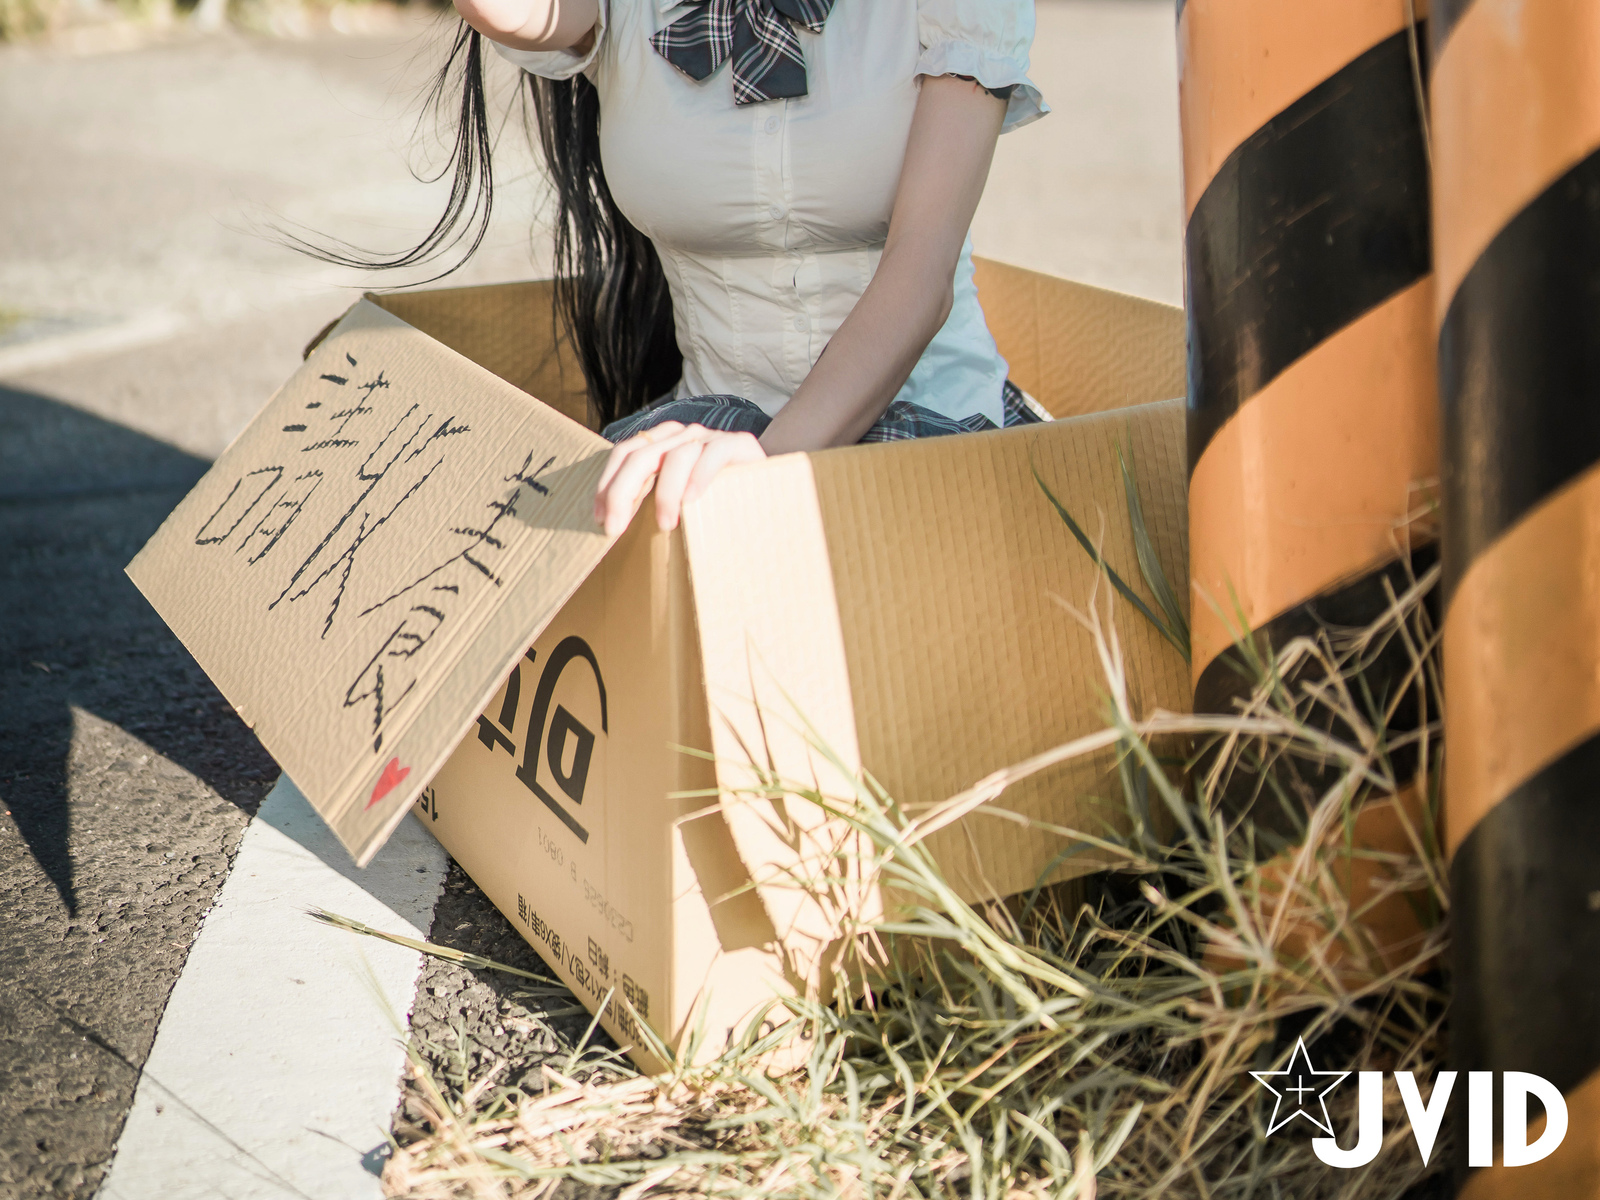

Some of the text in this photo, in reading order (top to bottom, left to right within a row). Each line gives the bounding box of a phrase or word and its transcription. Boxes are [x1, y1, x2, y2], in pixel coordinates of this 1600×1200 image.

[194, 351, 558, 754] 請收養
[416, 785, 438, 822] 15
